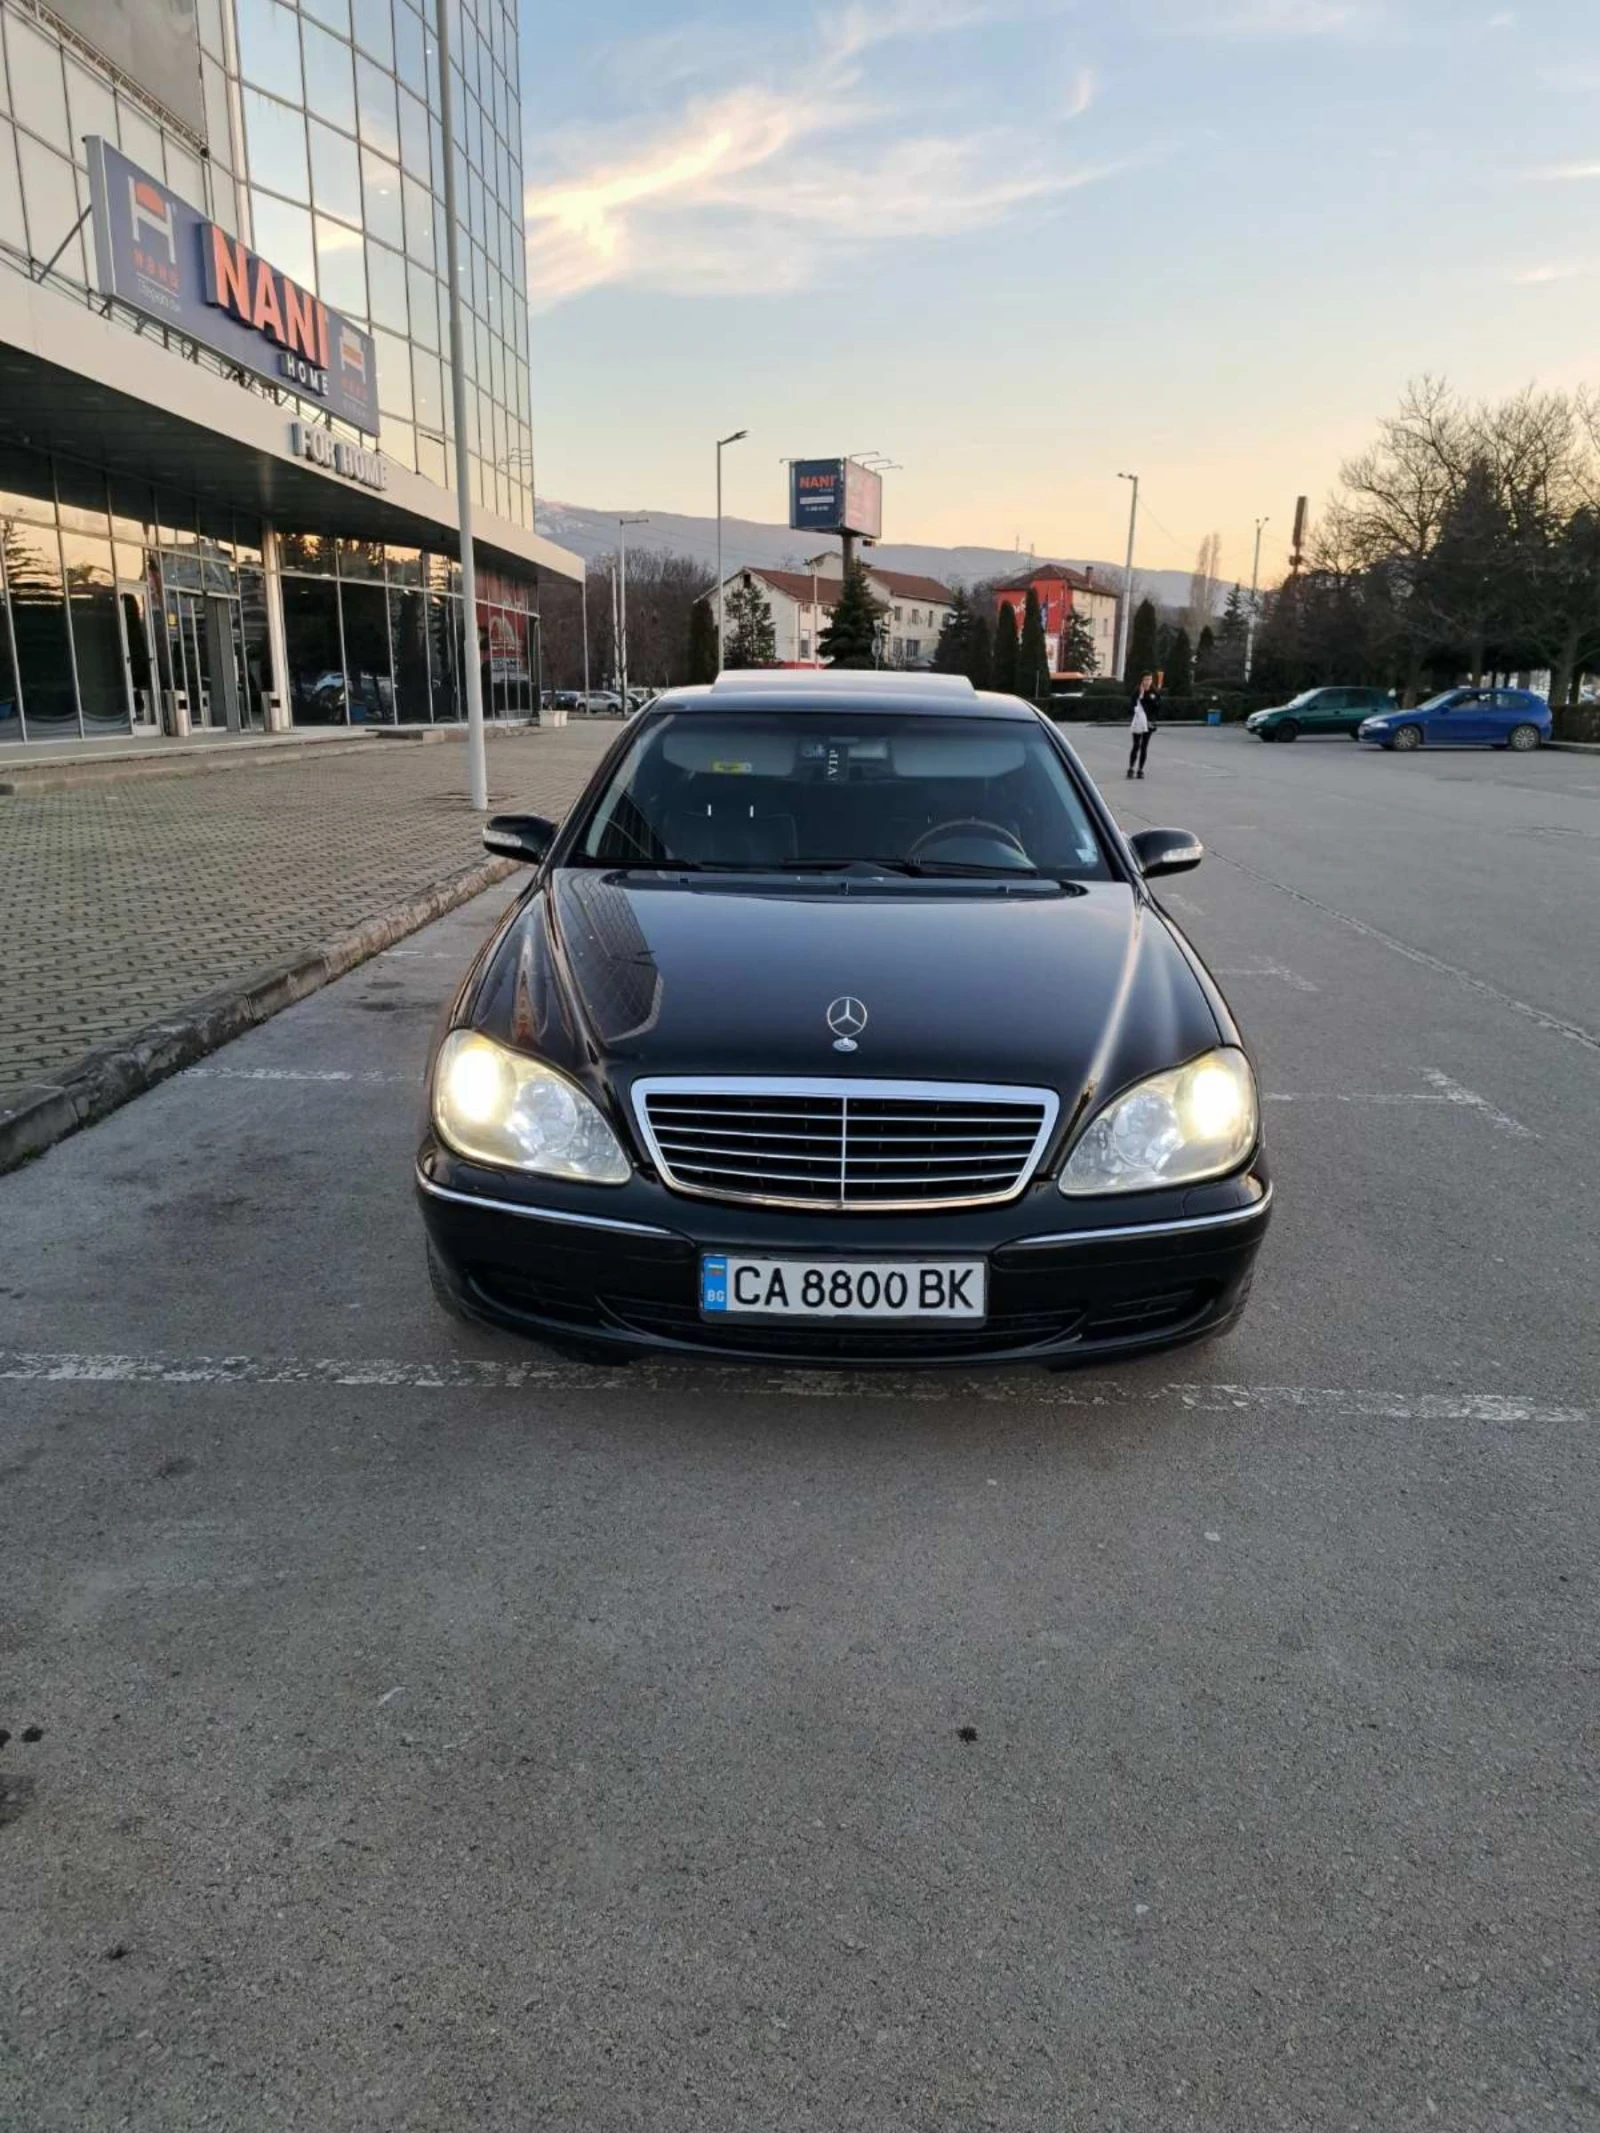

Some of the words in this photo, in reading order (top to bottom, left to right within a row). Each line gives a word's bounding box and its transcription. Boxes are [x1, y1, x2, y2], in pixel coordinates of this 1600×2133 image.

[207, 224, 330, 371] NANI
[283, 352, 330, 397] HOME
[296, 423, 336, 468] FOR
[338, 444, 387, 490] HOME
[799, 475, 834, 489] NANI
[707, 1289, 725, 1303] BG
[733, 1265, 789, 1308] CA
[801, 1269, 908, 1309] 8800
[918, 1268, 975, 1310] BK
